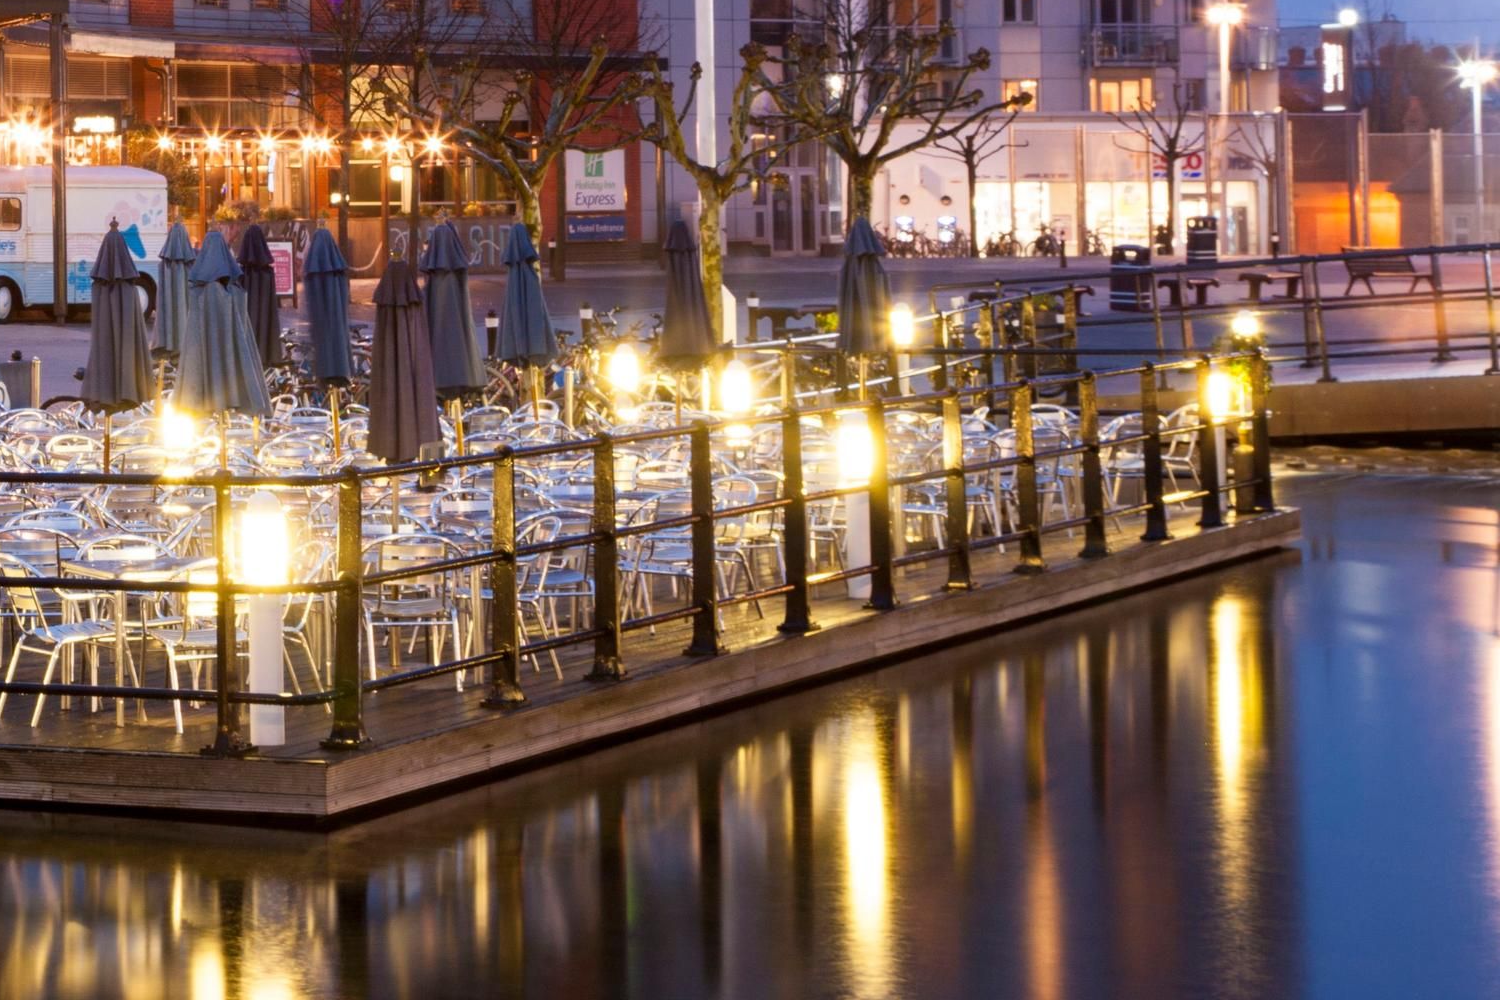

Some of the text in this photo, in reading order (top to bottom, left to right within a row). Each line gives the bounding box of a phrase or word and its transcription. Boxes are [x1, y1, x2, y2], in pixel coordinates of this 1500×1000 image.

[1129, 152, 1202, 170] TESO
[575, 192, 616, 208] Express
[577, 224, 625, 233] Hotel Entrance
